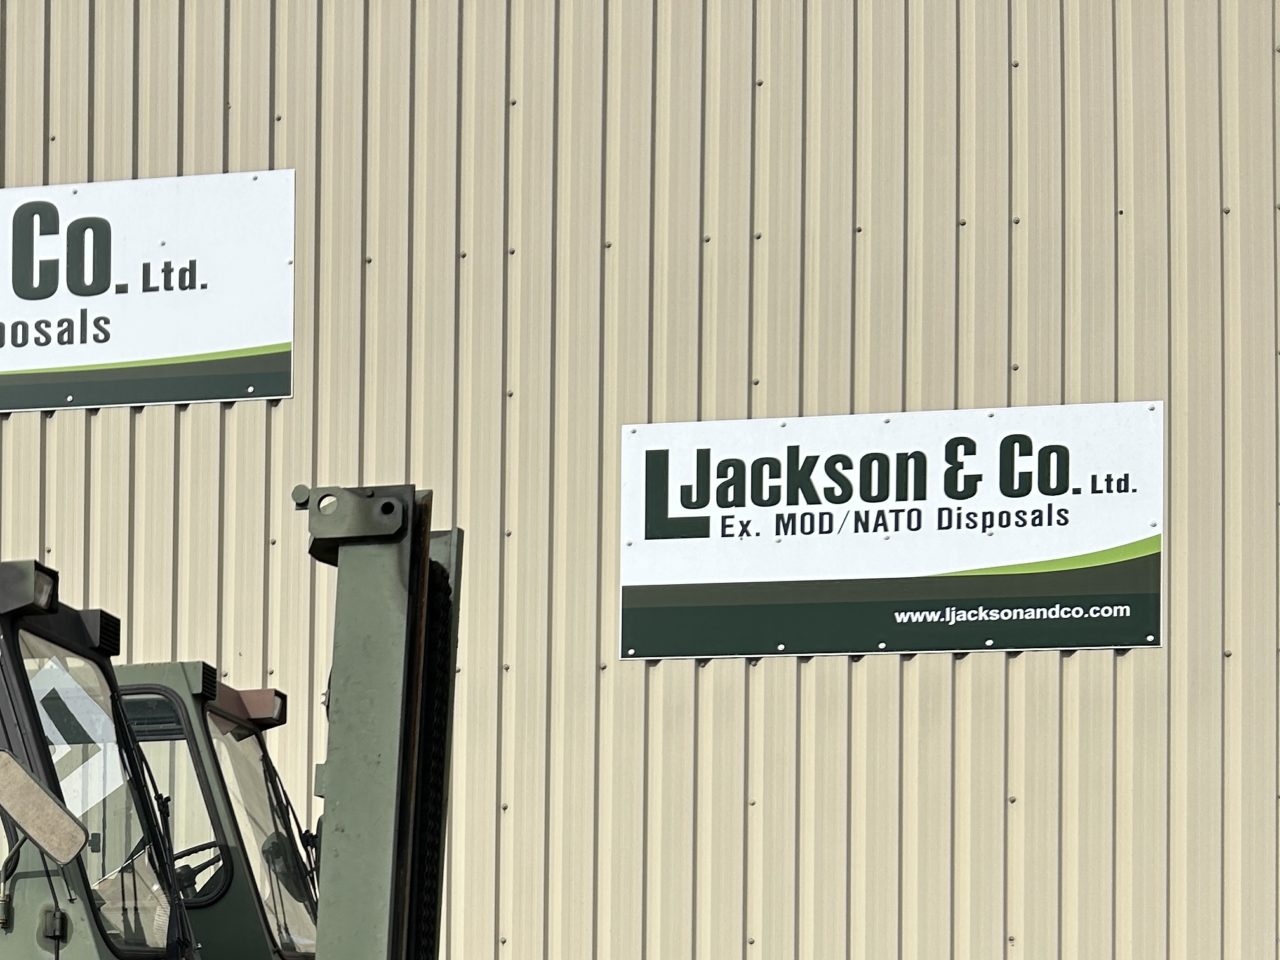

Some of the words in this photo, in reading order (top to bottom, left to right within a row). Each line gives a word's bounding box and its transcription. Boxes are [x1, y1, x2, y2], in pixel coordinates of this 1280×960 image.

[12, 201, 128, 300] Co.
[142, 260, 207, 292] Ltd.
[944, 437, 982, 500] &
[999, 434, 1081, 498] Co.
[1091, 473, 1137, 494] Ltd.
[721, 515, 761, 539] Ex.
[776, 508, 921, 535] MOD/NATO
[938, 503, 1069, 532] Disposals
[895, 604, 1130, 625] www.ljacksonandco.com
